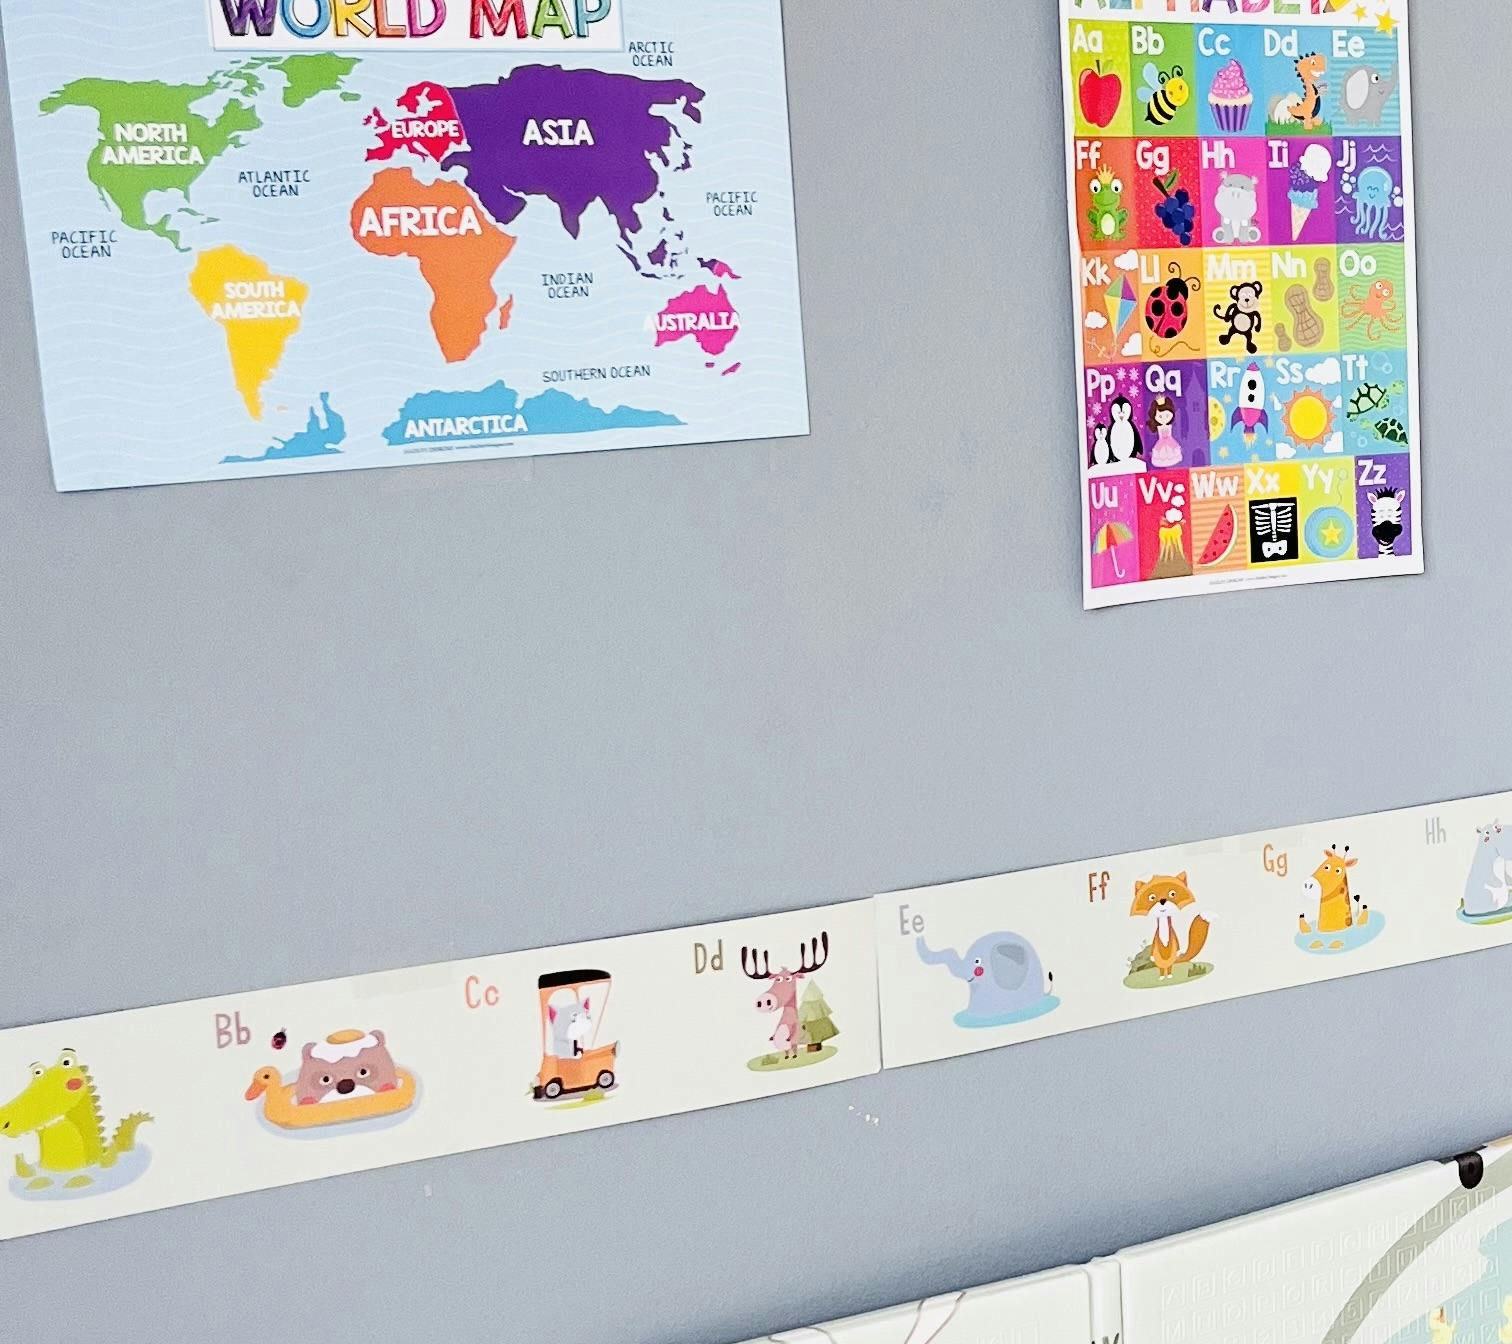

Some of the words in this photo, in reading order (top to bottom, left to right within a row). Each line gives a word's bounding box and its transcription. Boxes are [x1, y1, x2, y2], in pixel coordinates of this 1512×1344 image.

[629, 42, 674, 55] ARCTIC
[1072, 28, 1103, 54] Aa
[1132, 25, 1164, 55] Bb
[1198, 28, 1231, 56] Cc
[1264, 29, 1298, 57] Dd
[1332, 30, 1365, 57] Ee
[632, 54, 672, 67] OCEAN
[113, 123, 188, 143] NORTH
[391, 120, 460, 138] EUROPE
[522, 118, 594, 145] ASIA
[102, 146, 204, 165] AMERICA
[1076, 140, 1102, 170] Ff
[1136, 140, 1169, 175] Gg
[1201, 141, 1235, 168] Hh
[1268, 141, 1289, 168] Ii
[1336, 139, 1356, 172] Jj
[238, 170, 310, 184] ATLANTIC
[252, 184, 299, 197] OCEAN
[706, 191, 758, 204] PACIFIC
[359, 205, 482, 237] AFRICA
[714, 204, 752, 216] OCEAN
[51, 230, 118, 244] PACIFIC
[62, 245, 111, 258] OCEAN
[1339, 250, 1376, 275] Oo
[1081, 257, 1111, 286] Kk
[1206, 255, 1256, 280] Mm
[1272, 253, 1306, 277] Nn
[224, 281, 284, 299] SOUTH
[542, 273, 593, 287] INDIAN
[548, 286, 589, 298] OCEAN
[211, 300, 301, 319] AMERICA
[644, 312, 741, 332] AUSTRALIA
[542, 367, 607, 383] SOUTHERN
[611, 365, 651, 378] OCEAN
[1145, 365, 1181, 397] Qq
[1211, 360, 1240, 390] Rr
[1276, 358, 1302, 384] Ss
[1342, 355, 1368, 381] Tt
[1087, 368, 1116, 402] Pp
[404, 414, 528, 438] ANTARCTICA
[1191, 472, 1239, 498] Ww
[1248, 467, 1280, 494] Xx
[1302, 463, 1334, 495] Yy
[1357, 459, 1387, 485] Zz
[1091, 483, 1118, 510] Uu
[1139, 477, 1172, 505] Vv
[1425, 817, 1446, 846] Hh
[1263, 843, 1287, 877] Gg
[1088, 870, 1110, 903] Ff
[899, 904, 925, 936] Ee
[693, 939, 723, 974] Dd
[465, 975, 500, 1009] Cc
[214, 1011, 250, 1049] Bb
